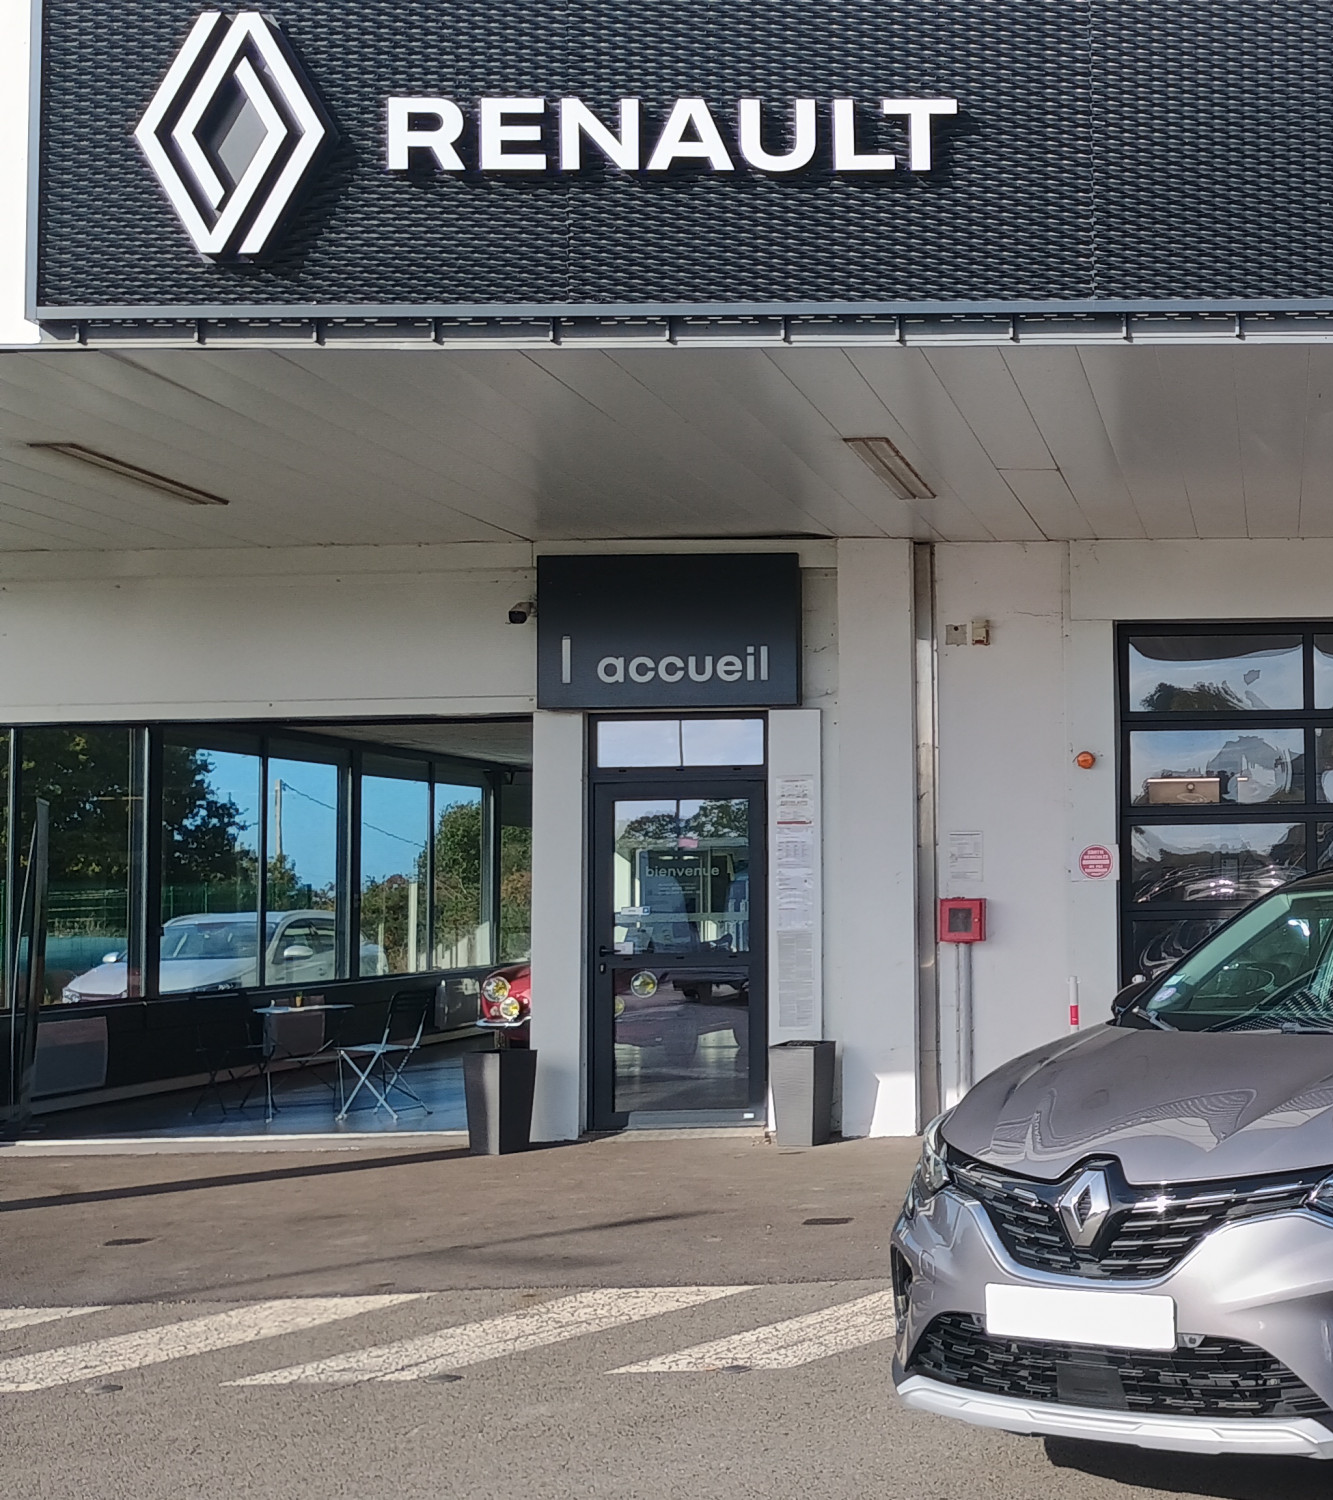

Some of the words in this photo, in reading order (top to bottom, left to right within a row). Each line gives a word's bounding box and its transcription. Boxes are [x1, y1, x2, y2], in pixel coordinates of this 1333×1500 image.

[386, 96, 958, 172] RENAULT
[597, 645, 769, 684] accueil
[646, 866, 720, 877] bienvenue
